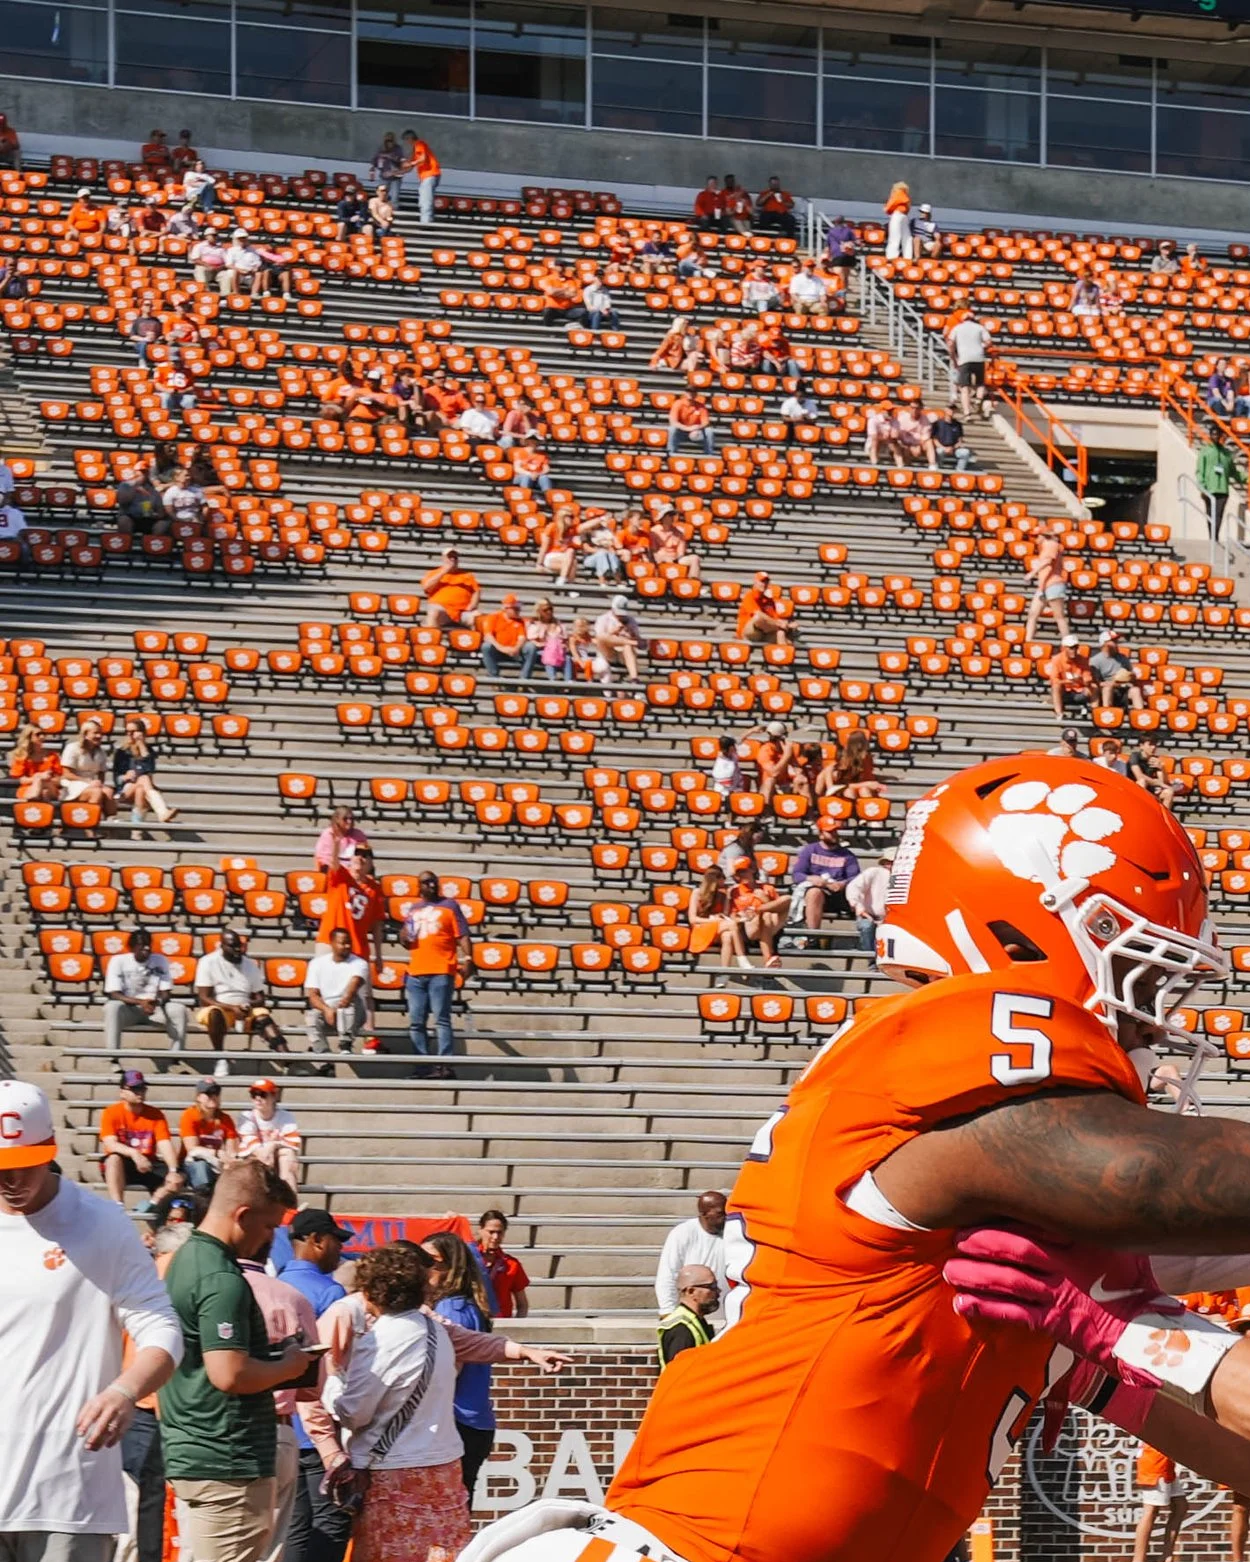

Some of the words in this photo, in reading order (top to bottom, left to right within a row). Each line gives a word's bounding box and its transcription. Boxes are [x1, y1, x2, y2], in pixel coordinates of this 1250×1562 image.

[990, 991, 1055, 1088] 5
[0, 1111, 23, 1139] C
[472, 1429, 637, 1511] BA
